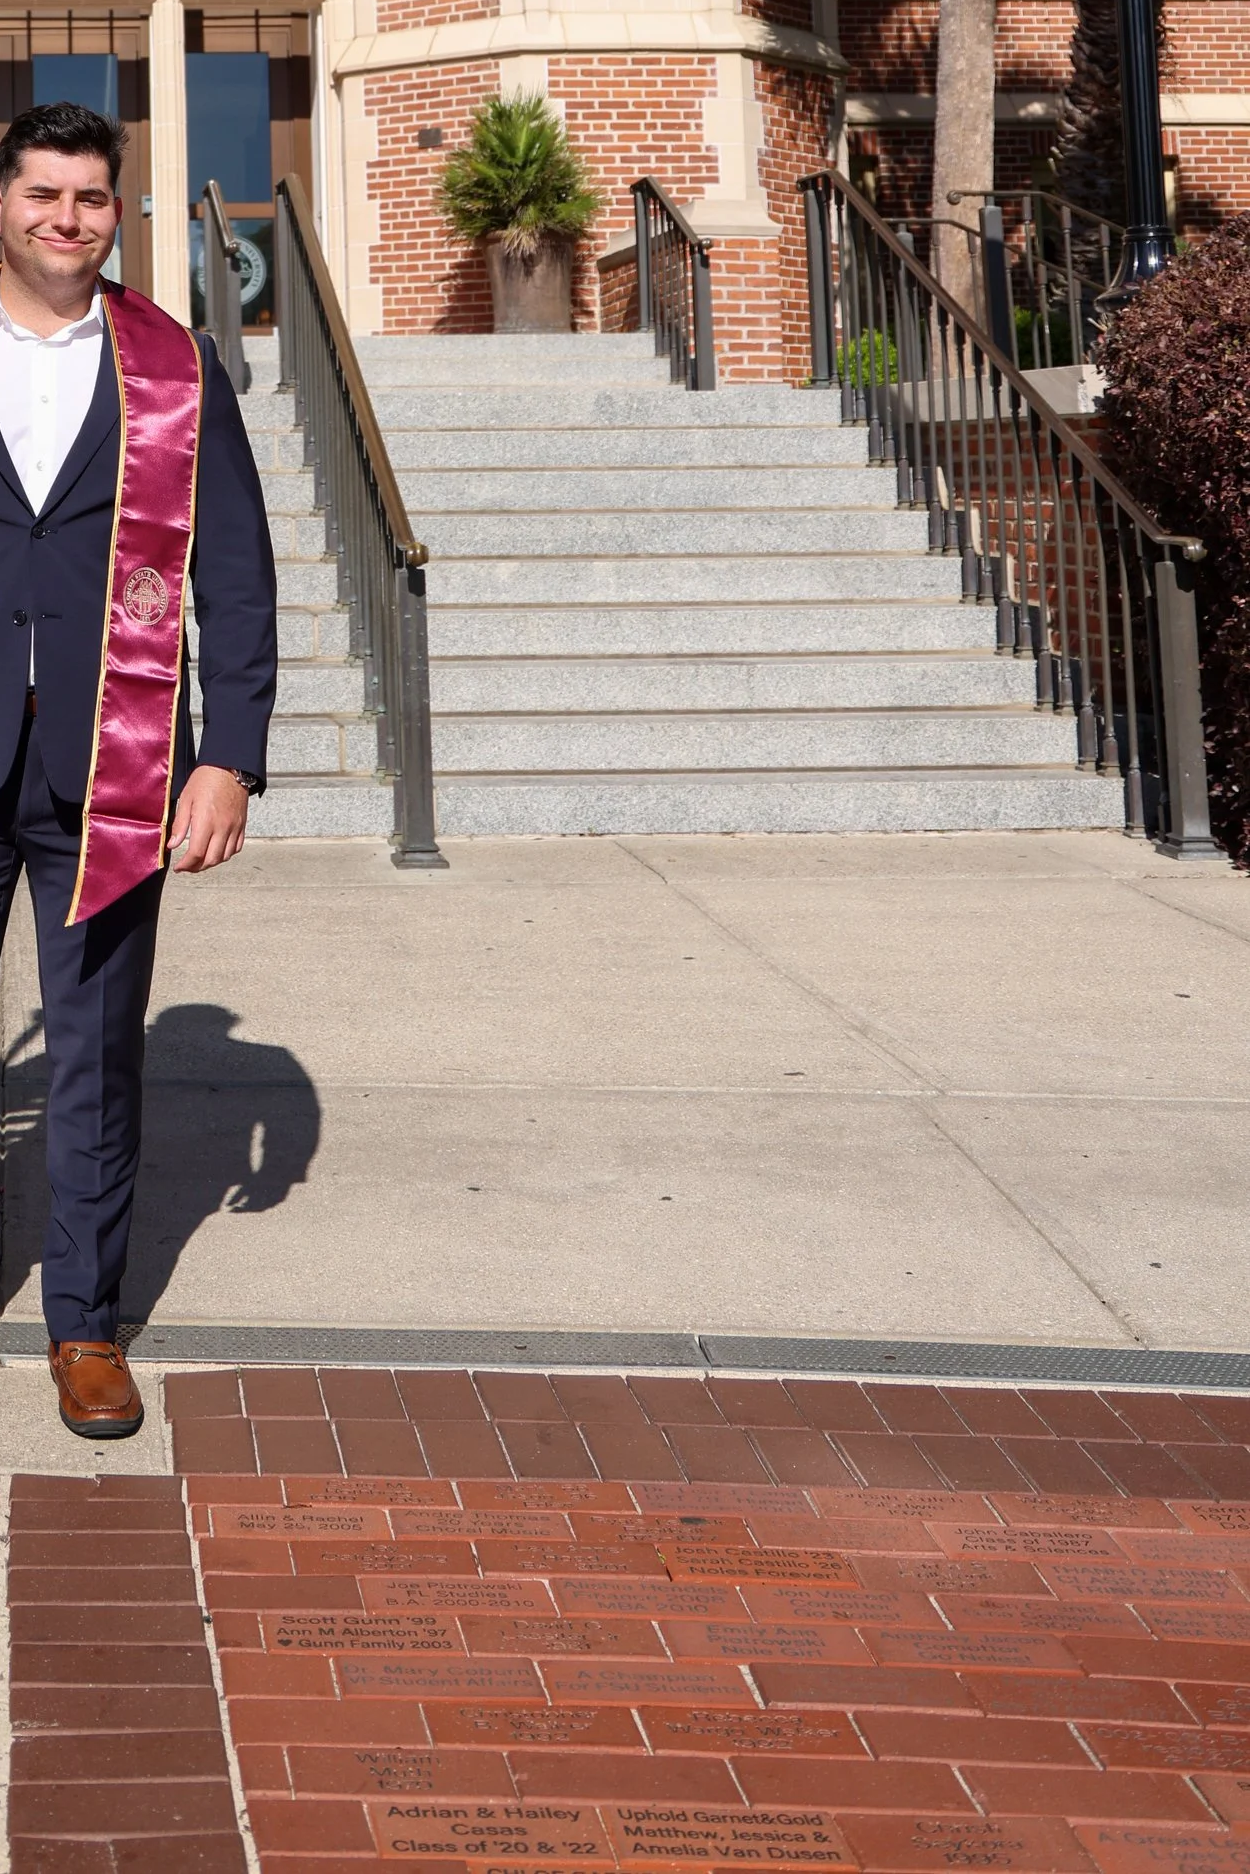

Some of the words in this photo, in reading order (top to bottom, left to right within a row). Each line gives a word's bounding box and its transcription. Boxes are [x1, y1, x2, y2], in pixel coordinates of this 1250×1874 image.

[302, 1514, 364, 1522] Rachel
[486, 1527, 551, 1536] Music
[953, 1527, 1000, 1537] John
[1003, 1528, 1093, 1540] Caballero
[965, 1536, 1017, 1545] Class
[1023, 1537, 1041, 1545] of
[1048, 1538, 1091, 1547] 1987
[675, 1546, 724, 1555] Josh
[726, 1547, 801, 1560] Castillo
[961, 1544, 998, 1552] Arts
[1024, 1546, 1111, 1556] Sciences
[676, 1556, 733, 1565] Sarah
[737, 1558, 811, 1570] Castillo
[688, 1565, 750, 1576] Noles
[755, 1567, 840, 1580] Forever!
[386, 1582, 421, 1590] Joe
[427, 1581, 523, 1591] Piotrowski
[406, 1590, 430, 1598] FL
[436, 1591, 508, 1599] Studies
[433, 1599, 536, 1608] 2000-2010
[598, 1602, 649, 1611] MBA
[794, 1609, 825, 1619] Go
[281, 1616, 337, 1626] Scott
[342, 1617, 400, 1626] Gunn
[405, 1616, 437, 1626] '99
[277, 1627, 313, 1637] Ann
[318, 1628, 335, 1636] M
[342, 1627, 419, 1638] Alberton
[422, 1628, 447, 1637] '97
[299, 1639, 347, 1649] Gunn
[350, 1639, 405, 1650] Family
[411, 1640, 452, 1650] 2003
[383, 1666, 438, 1677] Mary
[599, 1670, 717, 1683] Champion
[380, 1676, 460, 1687] Student
[555, 1681, 589, 1691] For
[593, 1682, 641, 1692] FSU
[649, 1682, 745, 1695] Students
[387, 1806, 468, 1820] Adrian
[476, 1807, 495, 1819] &
[504, 1807, 581, 1823] Hailey
[617, 1808, 689, 1824] Uphold
[693, 1810, 826, 1827] Garnet&Gold
[451, 1824, 528, 1837] Casas
[623, 1825, 725, 1840] Matthew,
[731, 1829, 807, 1843] Jessica
[813, 1831, 832, 1844] &
[391, 1840, 459, 1853] Class
[465, 1840, 489, 1853] of
[493, 1840, 530, 1854] '20
[537, 1841, 556, 1854] &
[561, 1841, 599, 1854] '22
[632, 1842, 710, 1858] Amelia
[713, 1844, 759, 1859] Van
[768, 1846, 842, 1861] Dusen
